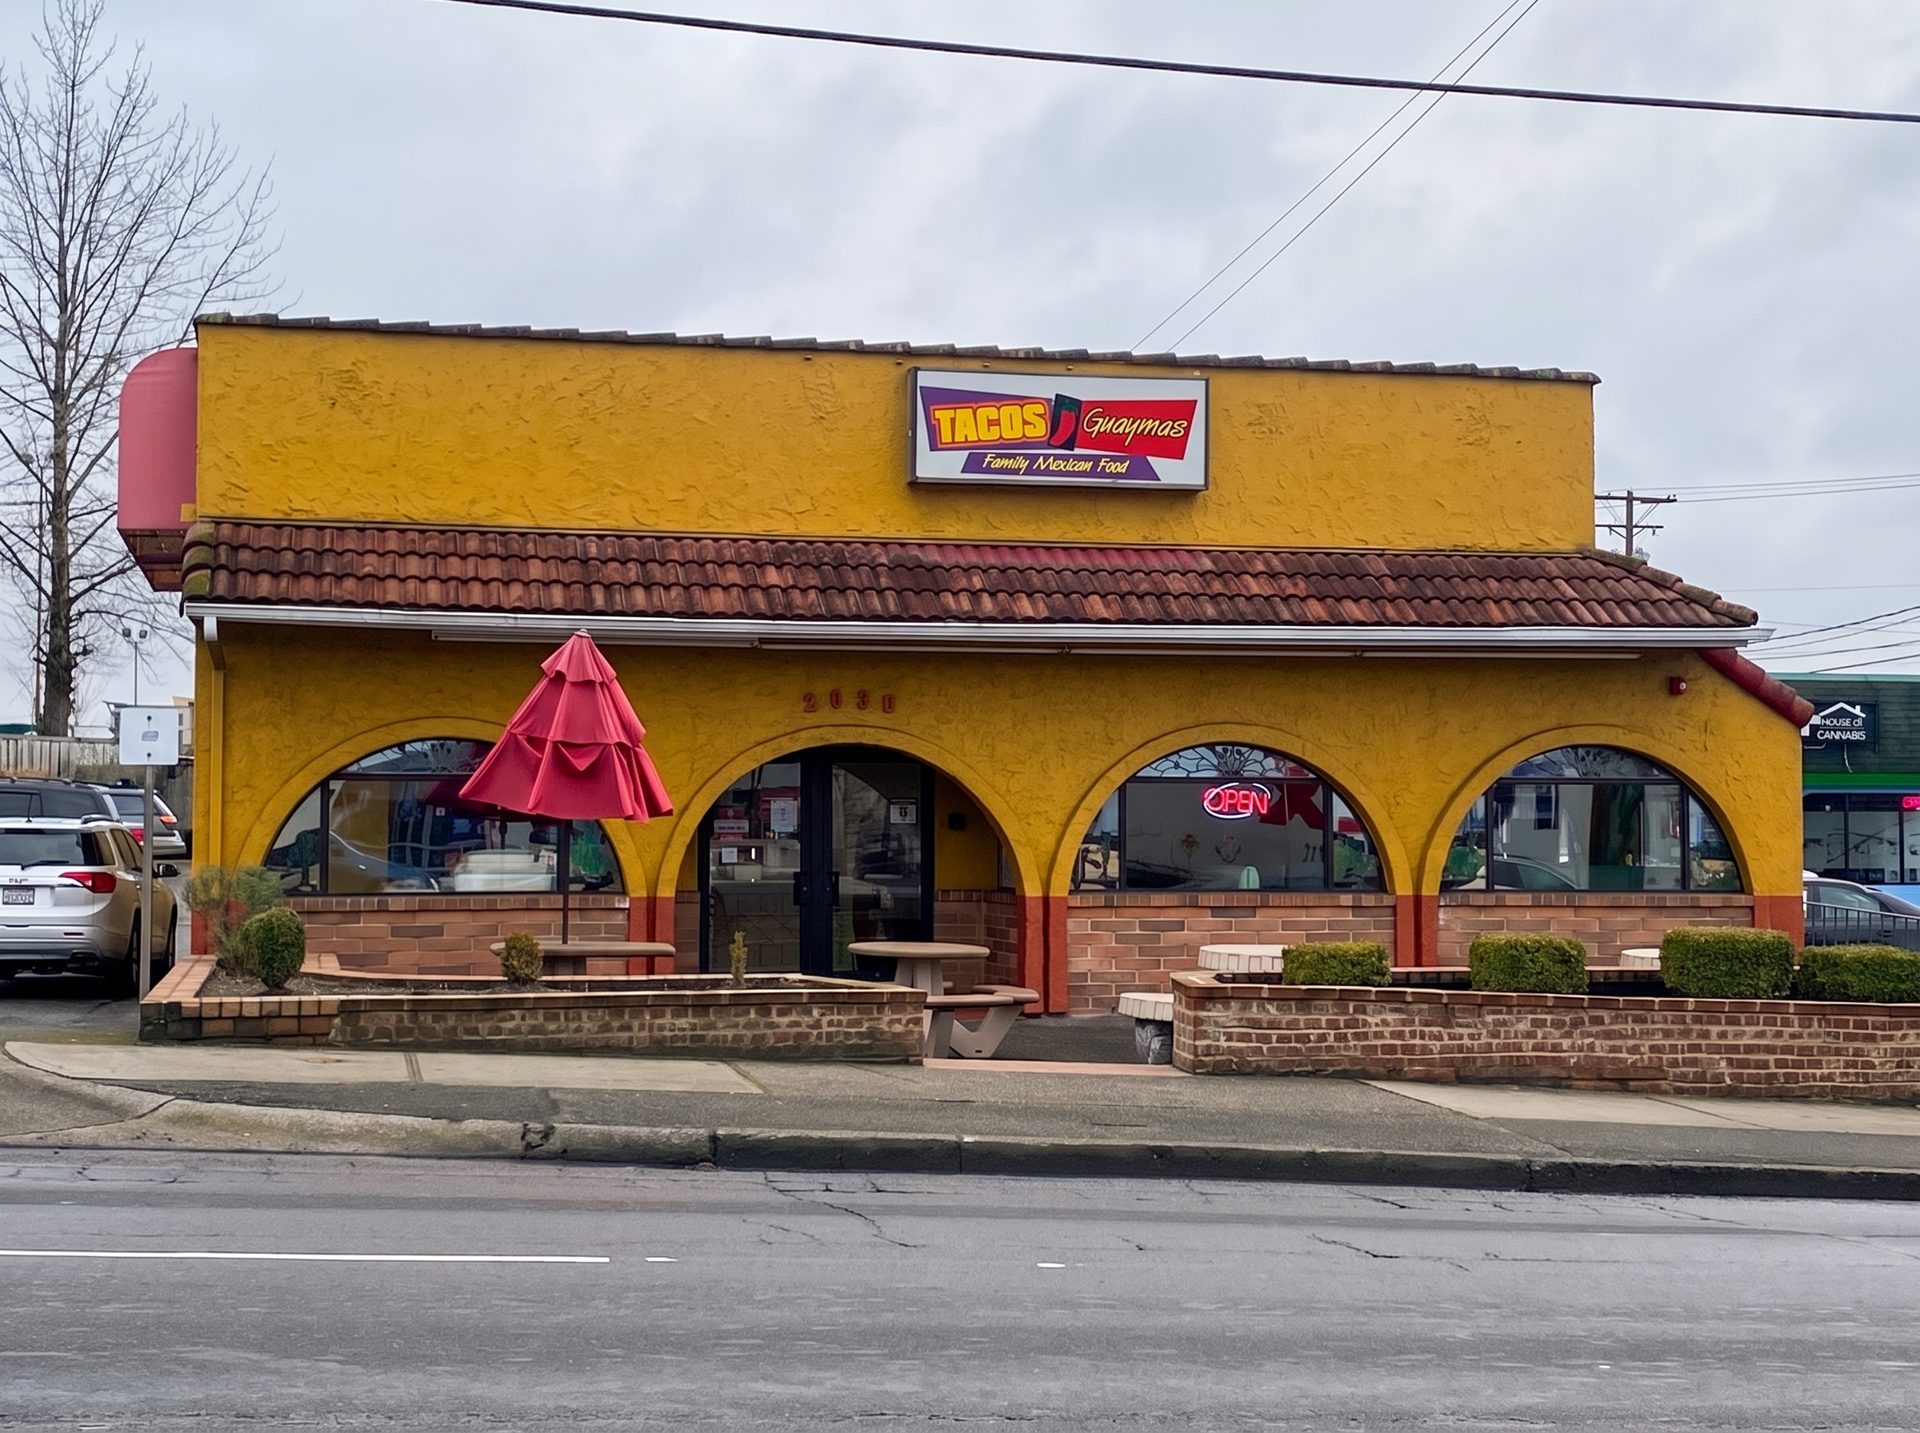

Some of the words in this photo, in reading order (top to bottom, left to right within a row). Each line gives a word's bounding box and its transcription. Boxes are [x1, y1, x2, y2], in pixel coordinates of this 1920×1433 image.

[933, 403, 1047, 445] TACOS
[1083, 408, 1188, 446] Guaymas
[982, 453, 1030, 475] Family
[1033, 455, 1092, 472] Mexican
[1096, 457, 1130, 474] Food
[803, 688, 896, 714] 2030
[1821, 717, 1852, 727] HOUSE
[1817, 730, 1866, 740] CANNABIS
[1204, 788, 1267, 814] OPEN
